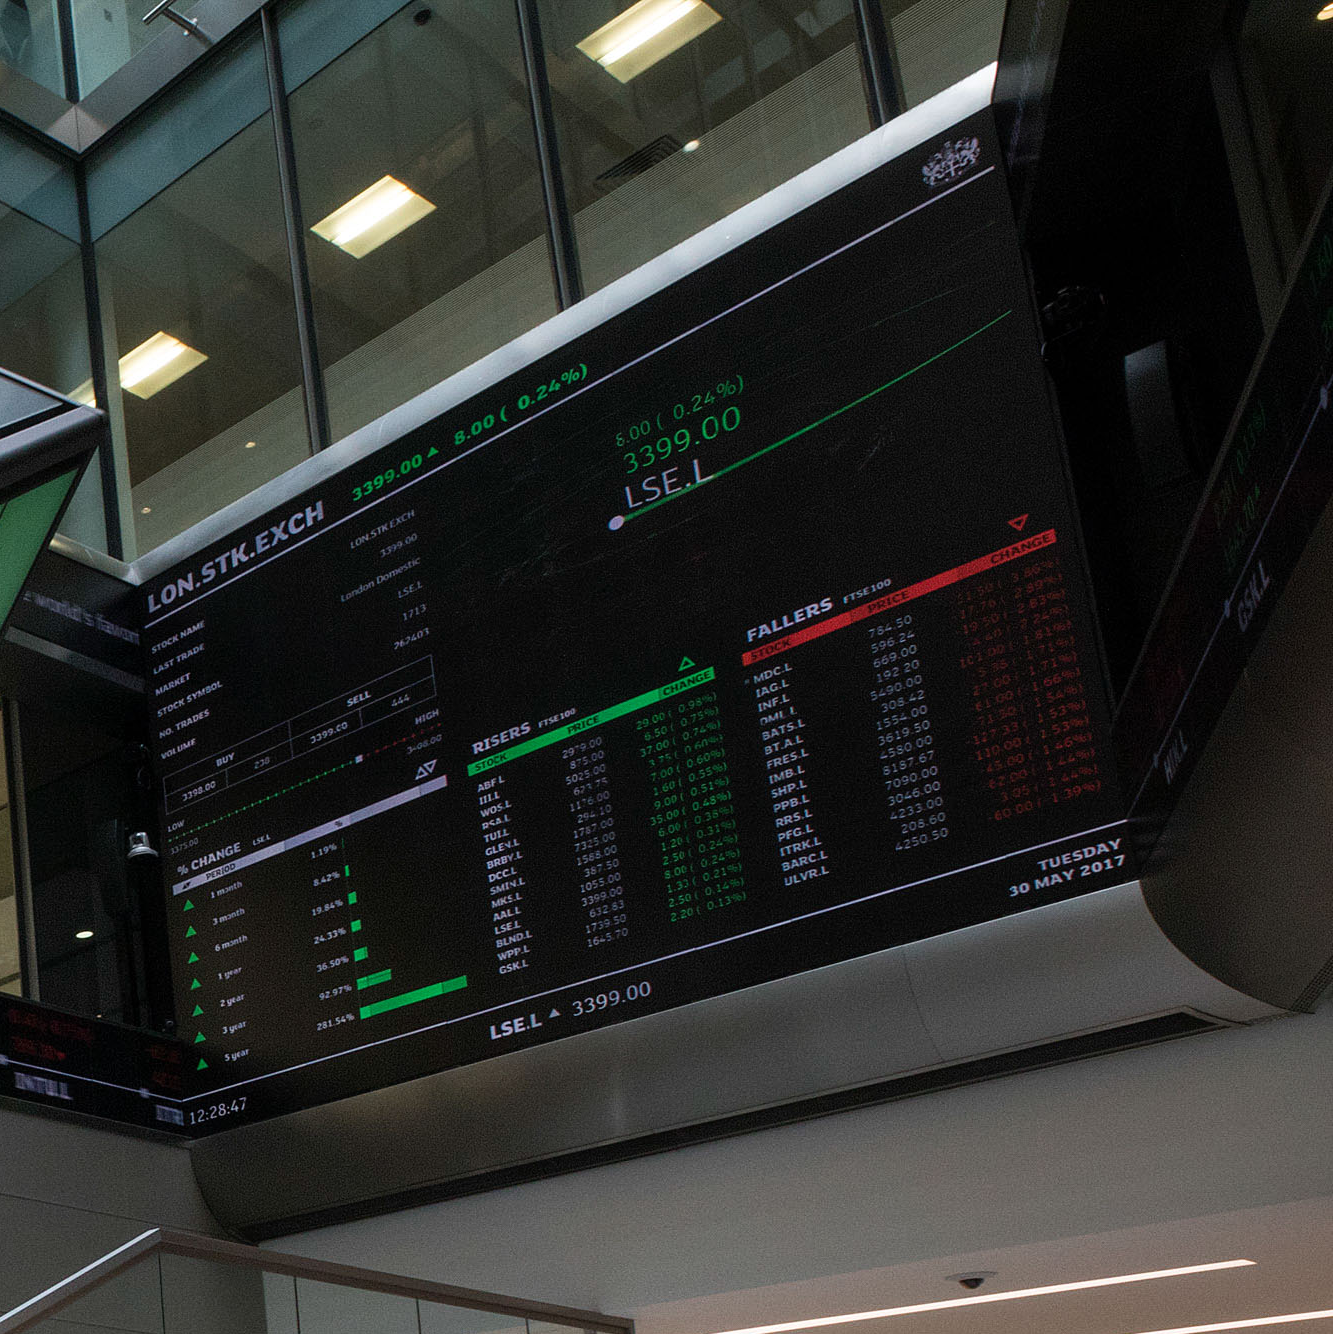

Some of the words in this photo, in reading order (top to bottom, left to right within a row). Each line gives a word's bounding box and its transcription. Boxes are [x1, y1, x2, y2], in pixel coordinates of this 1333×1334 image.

[624, 406, 741, 473] 3399.00
[148, 501, 323, 612] LON.STK.EXCH
[352, 453, 422, 501] 3399.00
[453, 413, 495, 445] 8.00
[517, 363, 587, 410] 0.24%)
[624, 459, 715, 508] LSE.L
[380, 532, 418, 557] 3399.00
[989, 530, 1049, 565] CHANGE
[340, 580, 375, 602] London
[375, 557, 419, 584] Domestic
[397, 580, 422, 599] LSE.L
[866, 588, 907, 614] PRICE
[402, 603, 427, 621] 1713
[746, 597, 833, 642] FALLERS
[868, 614, 913, 638] 784.50
[151, 633, 179, 654] STOCK
[179, 620, 204, 638] NAME
[870, 630, 915, 654] 596.24
[750, 635, 790, 661] STOCK
[872, 643, 917, 668] 669.00
[152, 657, 174, 675] LAST
[175, 643, 203, 662] TRADE
[660, 668, 709, 697] CHANGE
[752, 662, 792, 683] MDC.L
[154, 672, 190, 695] MARKET
[755, 678, 789, 699] IAG.L
[869, 674, 923, 701] 5490.00
[156, 697, 185, 717] STOCK
[185, 680, 222, 703] SYMBOL
[346, 690, 371, 707] SELL
[757, 693, 790, 713] INF.L
[881, 688, 925, 713] 308.42
[158, 726, 173, 739] NO.
[175, 708, 210, 730] TRADES
[414, 708, 439, 725] HIGH
[567, 714, 599, 734] PRICE
[876, 704, 928, 731] 1554.00
[471, 721, 531, 754] RISERS
[761, 718, 805, 741] BATS.L
[878, 719, 931, 746] 3619.50
[160, 737, 195, 759] VOLUME
[763, 734, 804, 756] BT.A.L
[215, 751, 235, 767] BUY
[474, 750, 507, 772] STOCK
[765, 748, 809, 769] FRES.L
[882, 749, 934, 776] 8187.67
[768, 764, 805, 784] IMB.L
[884, 764, 939, 790] 7090.00
[182, 780, 216, 801] 3398.00
[770, 779, 807, 799] SHP.L
[888, 780, 941, 806] 3046.00
[479, 799, 511, 818] WOS.L
[772, 794, 810, 813] PPB.L
[889, 795, 943, 820] 4233.00
[166, 819, 185, 833] LOW
[774, 808, 812, 828] RRS.L
[900, 811, 946, 835] 208.60
[776, 823, 814, 842] PFG.L
[894, 826, 949, 851] 4250.50
[779, 836, 821, 857] ITRK.L
[1037, 838, 1121, 870] TUESDAY
[176, 864, 189, 876] %
[190, 841, 240, 870] CHANGE
[485, 850, 522, 870] BRBY.L
[781, 850, 828, 872] BARC.L
[205, 862, 236, 881] PERIOD
[312, 871, 340, 887] 8.42%
[487, 866, 517, 883] DCC.L
[783, 865, 829, 886] ULVR.L
[1009, 881, 1031, 897] 30
[1033, 868, 1074, 890] MAY
[1079, 853, 1125, 877] 2017
[215, 880, 243, 896] month
[311, 899, 343, 916] 19.84%
[490, 891, 522, 908] MKS.L
[218, 907, 245, 923] month
[492, 905, 521, 922] AAL.L
[313, 927, 346, 945] 24.33%
[493, 919, 521, 935] LSE.L
[220, 934, 248, 949] month
[495, 929, 532, 948] BLND.L
[496, 944, 530, 961] WPP.L
[223, 966, 242, 980] year
[316, 955, 349, 972] 36.50%
[498, 959, 528, 975] GSK.L
[226, 993, 244, 1007] year
[318, 984, 352, 1000] 92.97%
[489, 1013, 542, 1040] LSE.L
[572, 980, 652, 1016] 3399.00
[228, 1020, 246, 1034] year
[316, 1013, 355, 1031] 281.54%
[230, 1048, 249, 1061] year
[189, 1096, 246, 1125] 12:28:47
